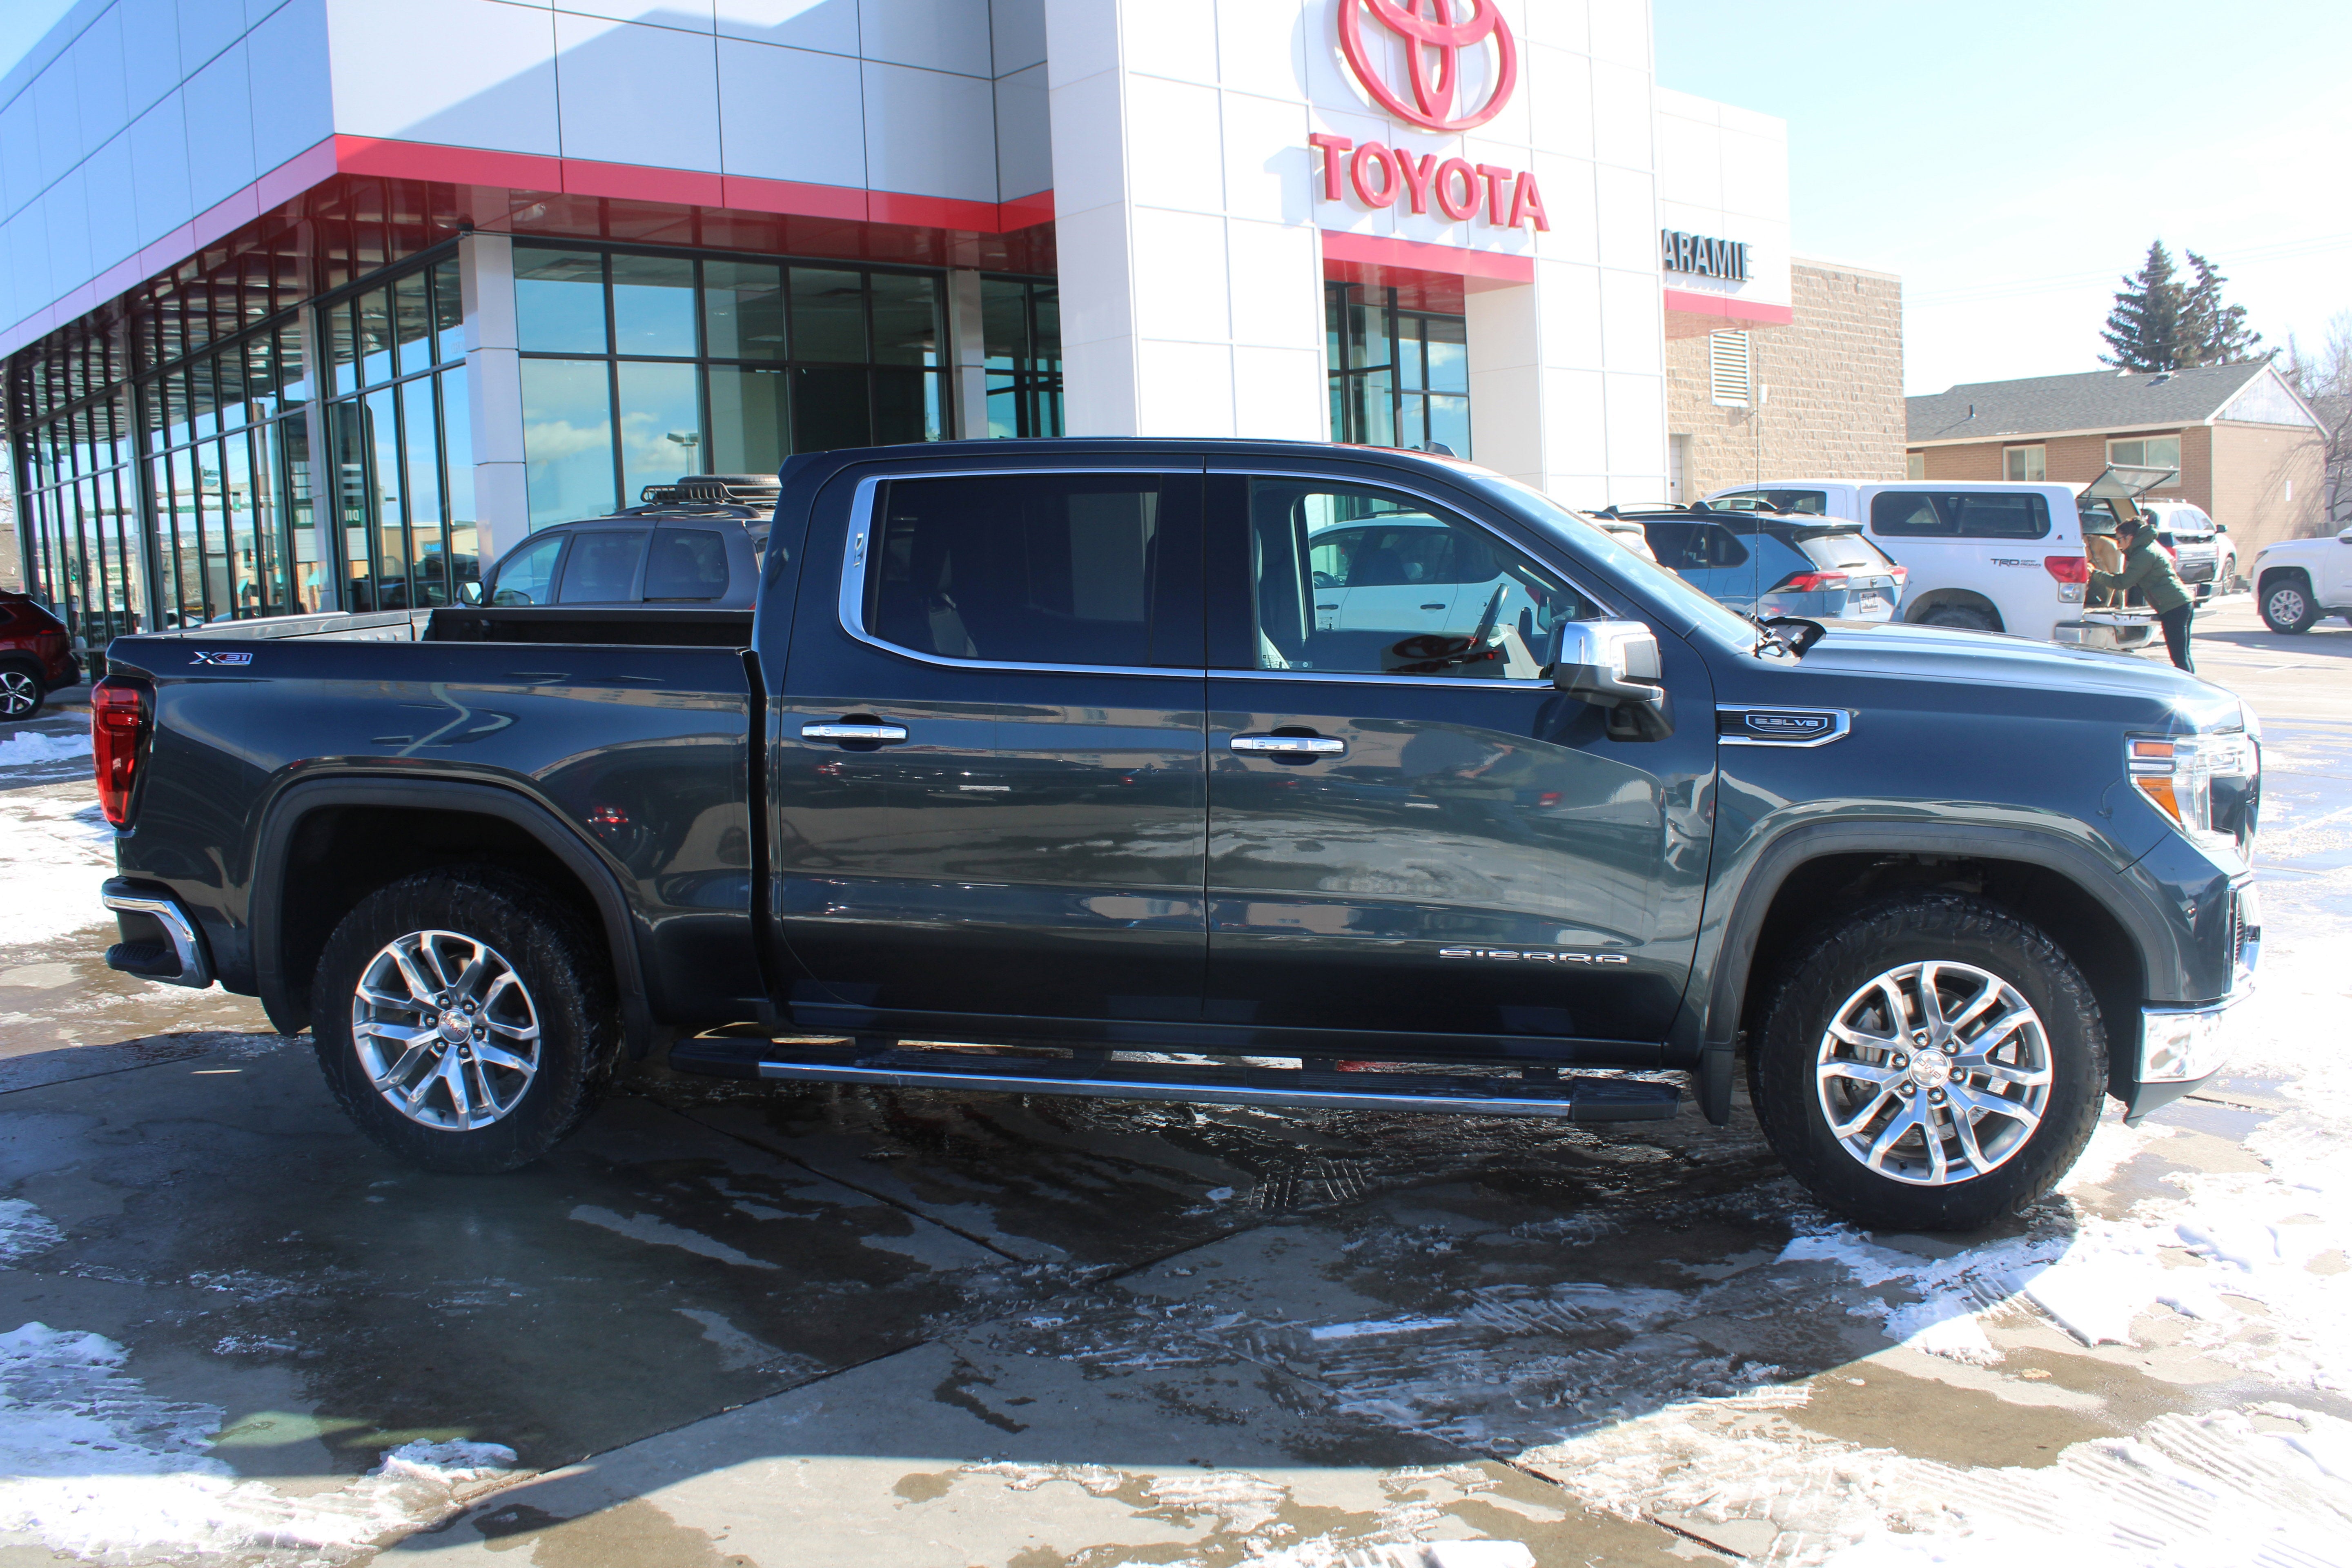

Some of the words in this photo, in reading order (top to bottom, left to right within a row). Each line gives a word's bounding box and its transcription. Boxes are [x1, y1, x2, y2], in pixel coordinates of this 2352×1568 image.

[1310, 132, 1550, 232] TOYOTA
[1990, 558, 2019, 567] TRD
[1439, 948, 1628, 965] SIERRA
[443, 1018, 465, 1037] GMC
[1917, 1058, 1941, 1079] GMC
